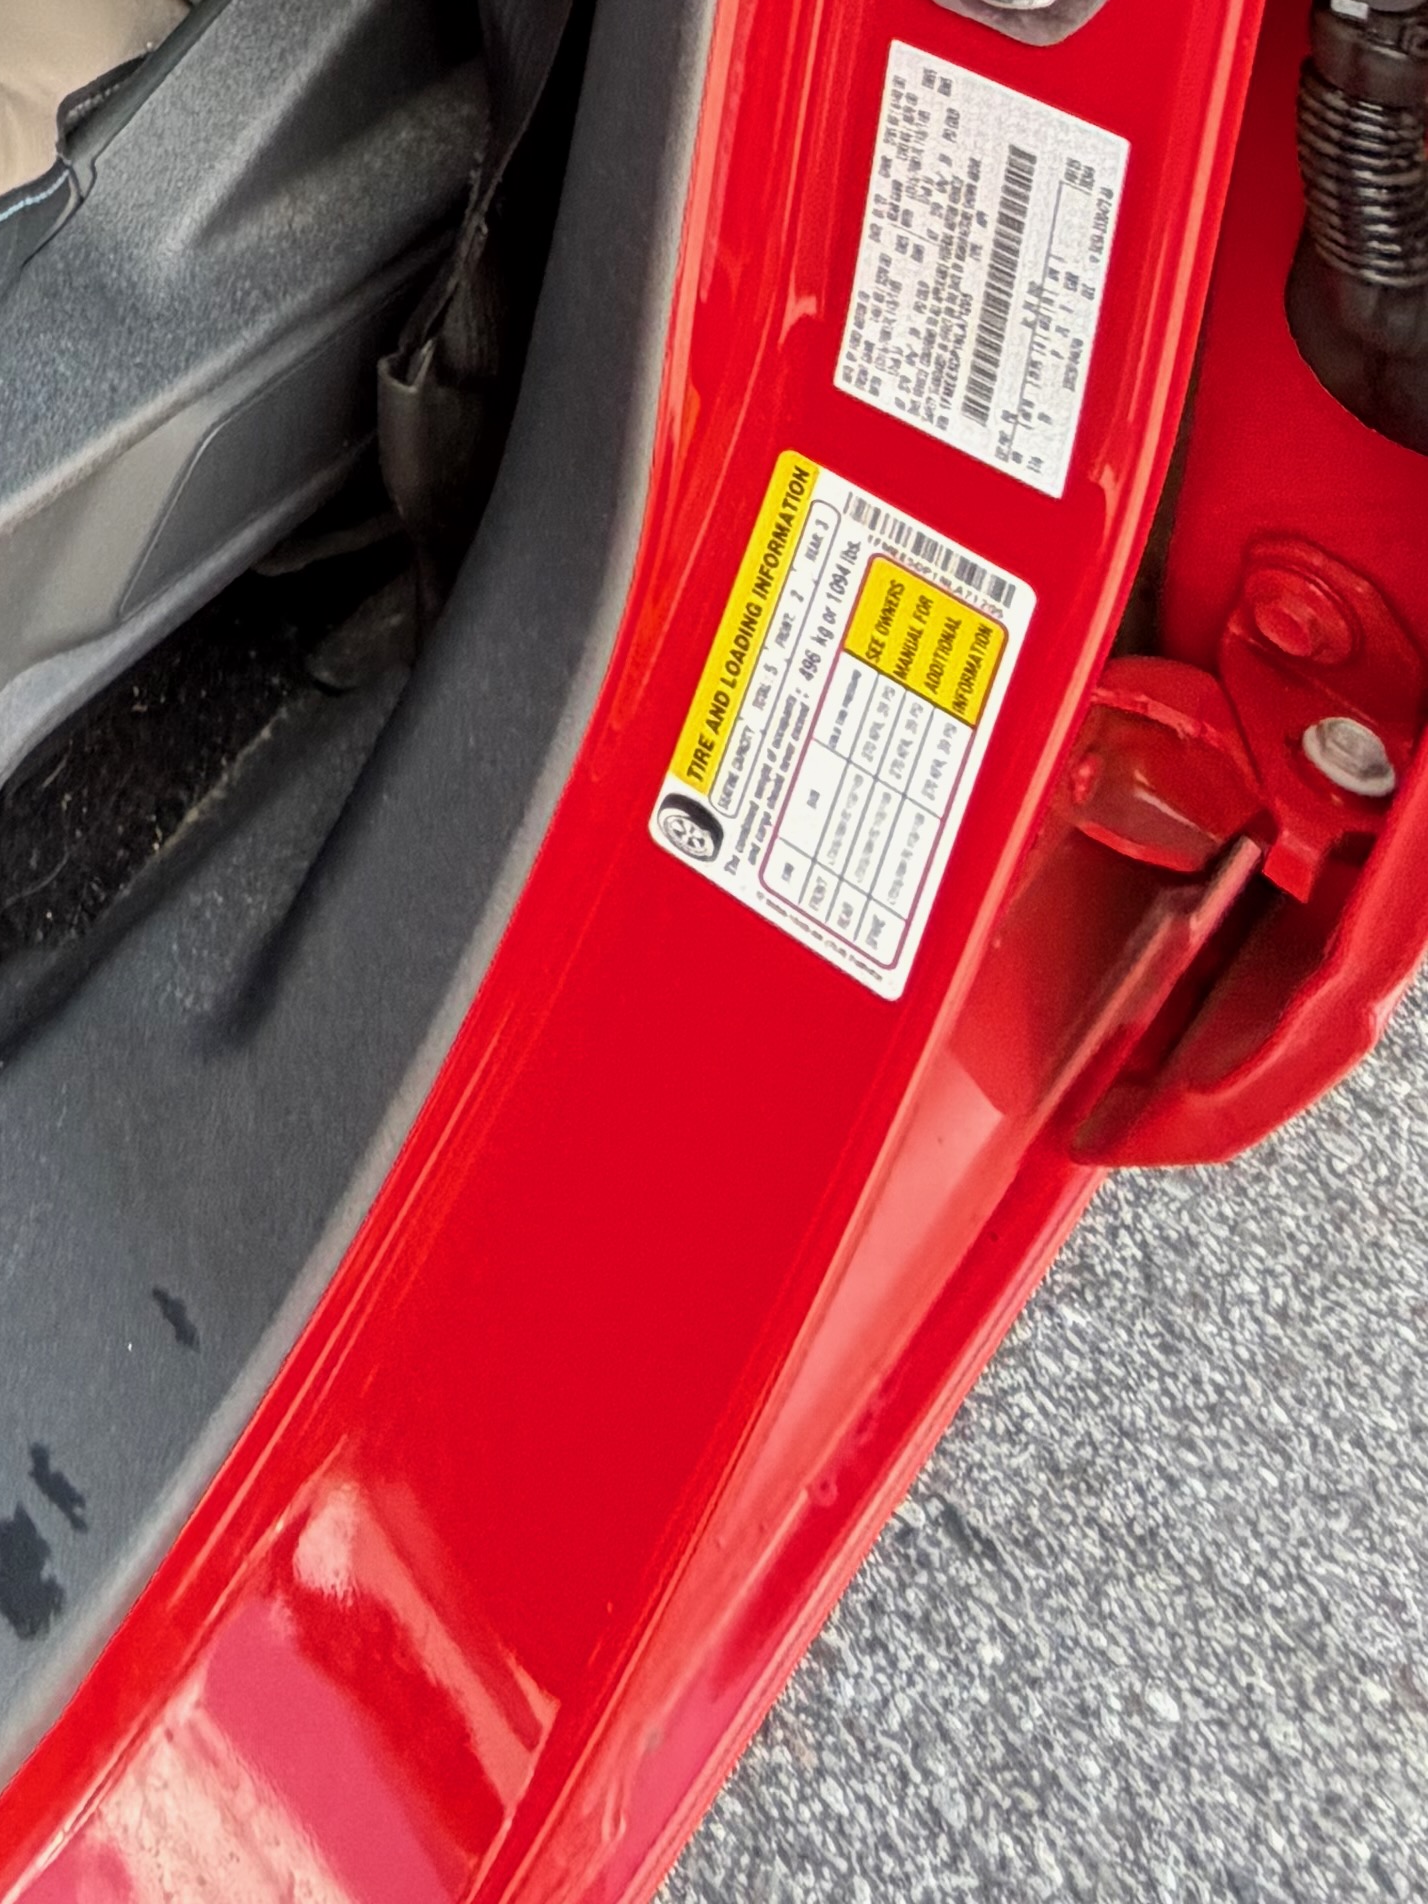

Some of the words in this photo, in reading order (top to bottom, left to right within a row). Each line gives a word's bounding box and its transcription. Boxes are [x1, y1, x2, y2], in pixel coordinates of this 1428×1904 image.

[839, 540, 861, 565] lbs.
[789, 589, 804, 602] 2
[826, 563, 850, 602] 1094
[686, 733, 714, 781] TIRE
[705, 690, 729, 734] AND
[720, 602, 761, 688] LOADING
[752, 466, 808, 598] INFORMATION
[822, 605, 836, 624] or
[874, 579, 904, 635] OWNERS
[810, 625, 833, 646] kg
[865, 636, 885, 662] SEE
[893, 626, 923, 679] MANUAL
[912, 594, 933, 624] FOR
[799, 649, 821, 680] 496
[924, 616, 961, 693] ADDITIONAL
[952, 623, 992, 713] INFORMATION
